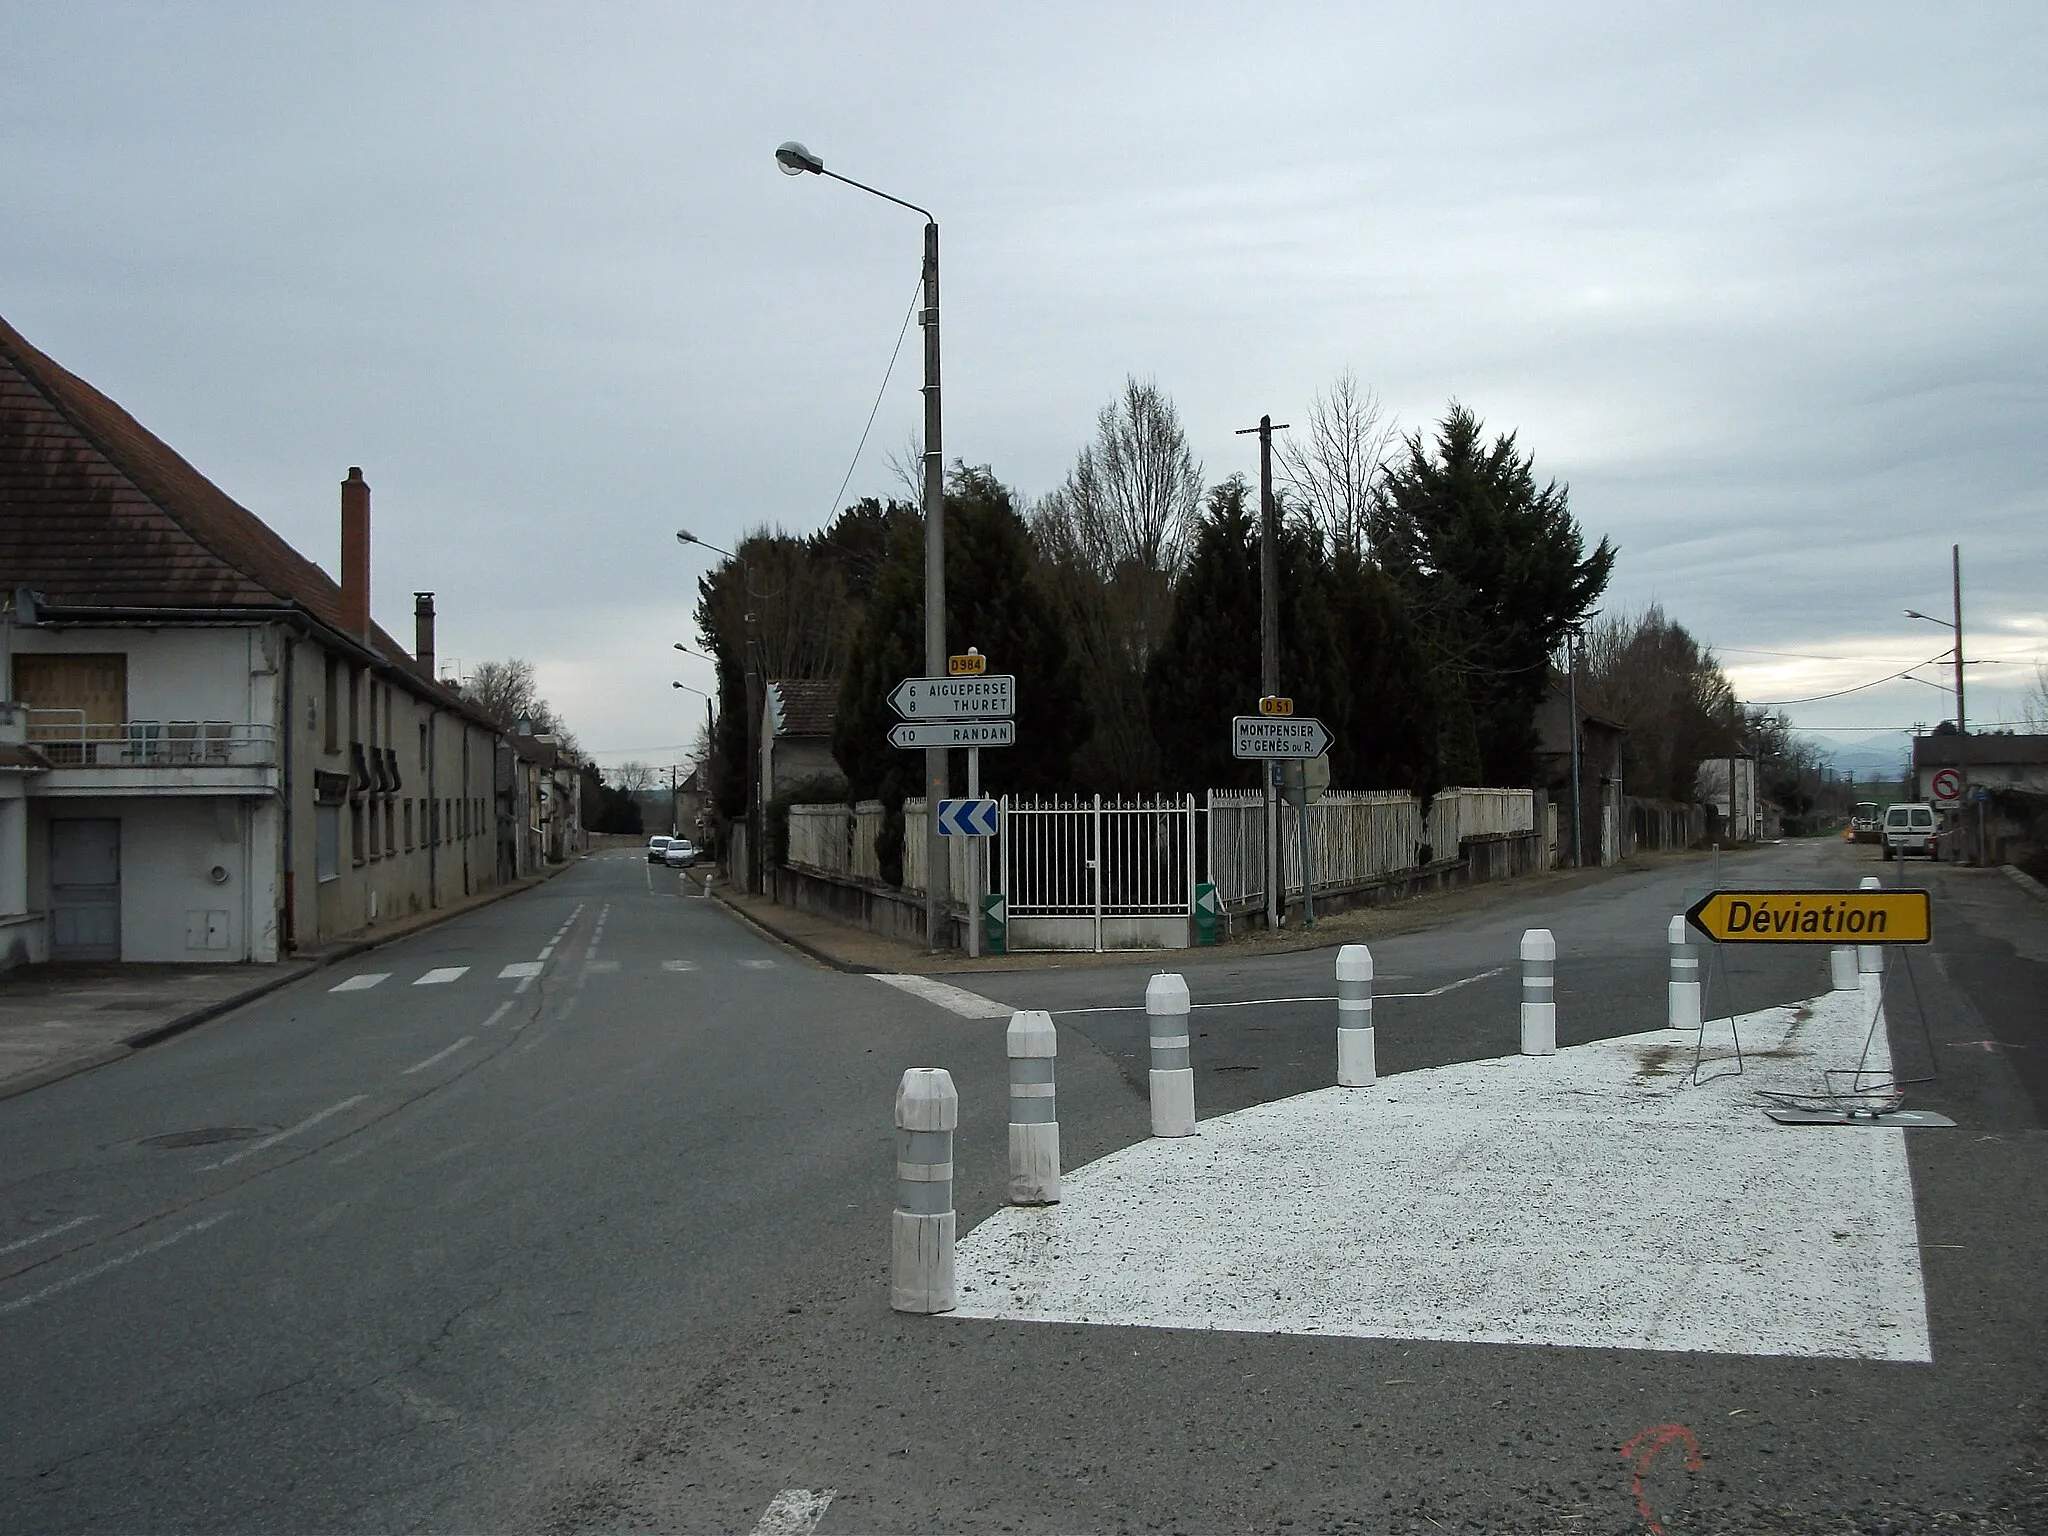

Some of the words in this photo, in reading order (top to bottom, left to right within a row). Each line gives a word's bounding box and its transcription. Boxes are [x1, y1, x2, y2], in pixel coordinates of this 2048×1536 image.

[909, 686, 916, 696] 6
[929, 683, 1007, 696] AIGUEPERSE
[909, 701, 916, 711] 8
[954, 699, 1007, 711] THURET
[902, 731, 915, 741] 10
[953, 728, 1007, 741] RANDAN
[1240, 725, 1314, 736] MONTPENSIER
[1727, 901, 1888, 933] Déviation
